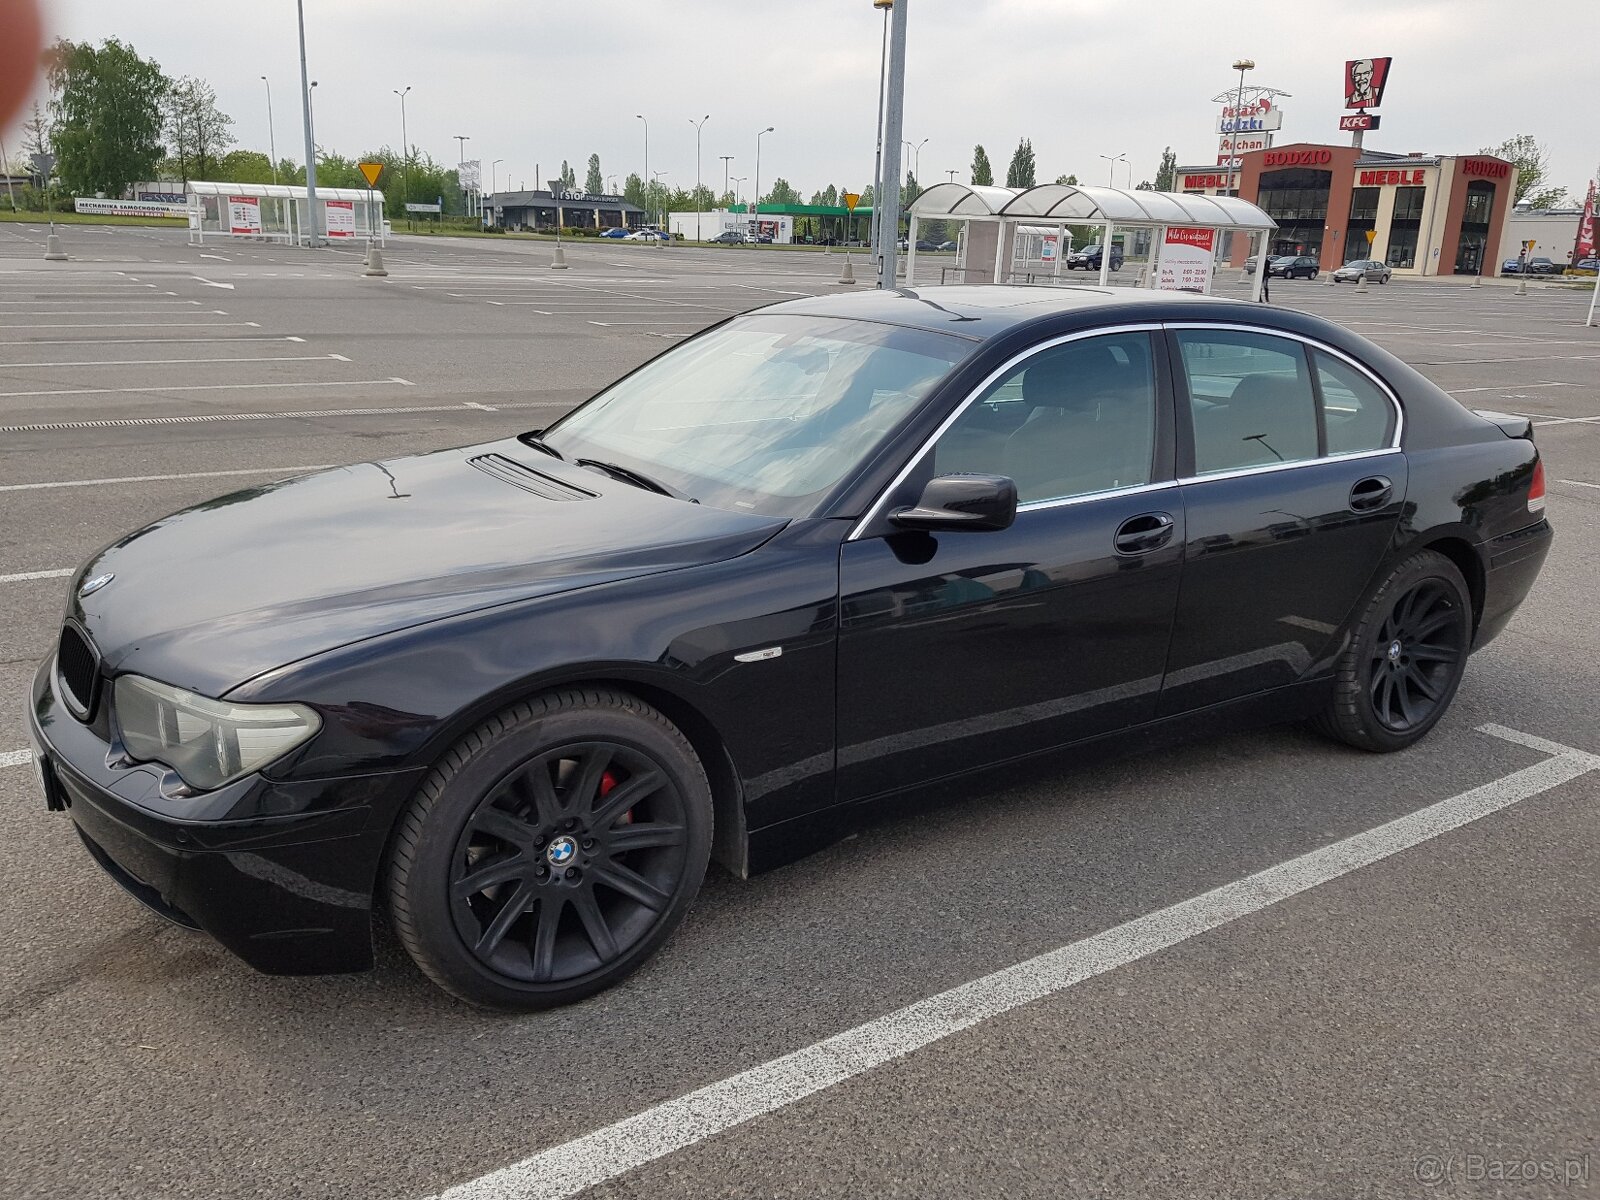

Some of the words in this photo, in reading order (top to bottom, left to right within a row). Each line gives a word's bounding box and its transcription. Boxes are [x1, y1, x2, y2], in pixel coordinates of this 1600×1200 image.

[1342, 117, 1368, 128] KFC
[1264, 150, 1331, 166] BODZIO
[1463, 159, 1508, 179] BODZIO
[1360, 170, 1425, 185] MEBLE
[565, 191, 585, 201] STOP
[79, 201, 118, 210] MECHANIKA
[119, 204, 170, 212] SAMOCHODOWA
